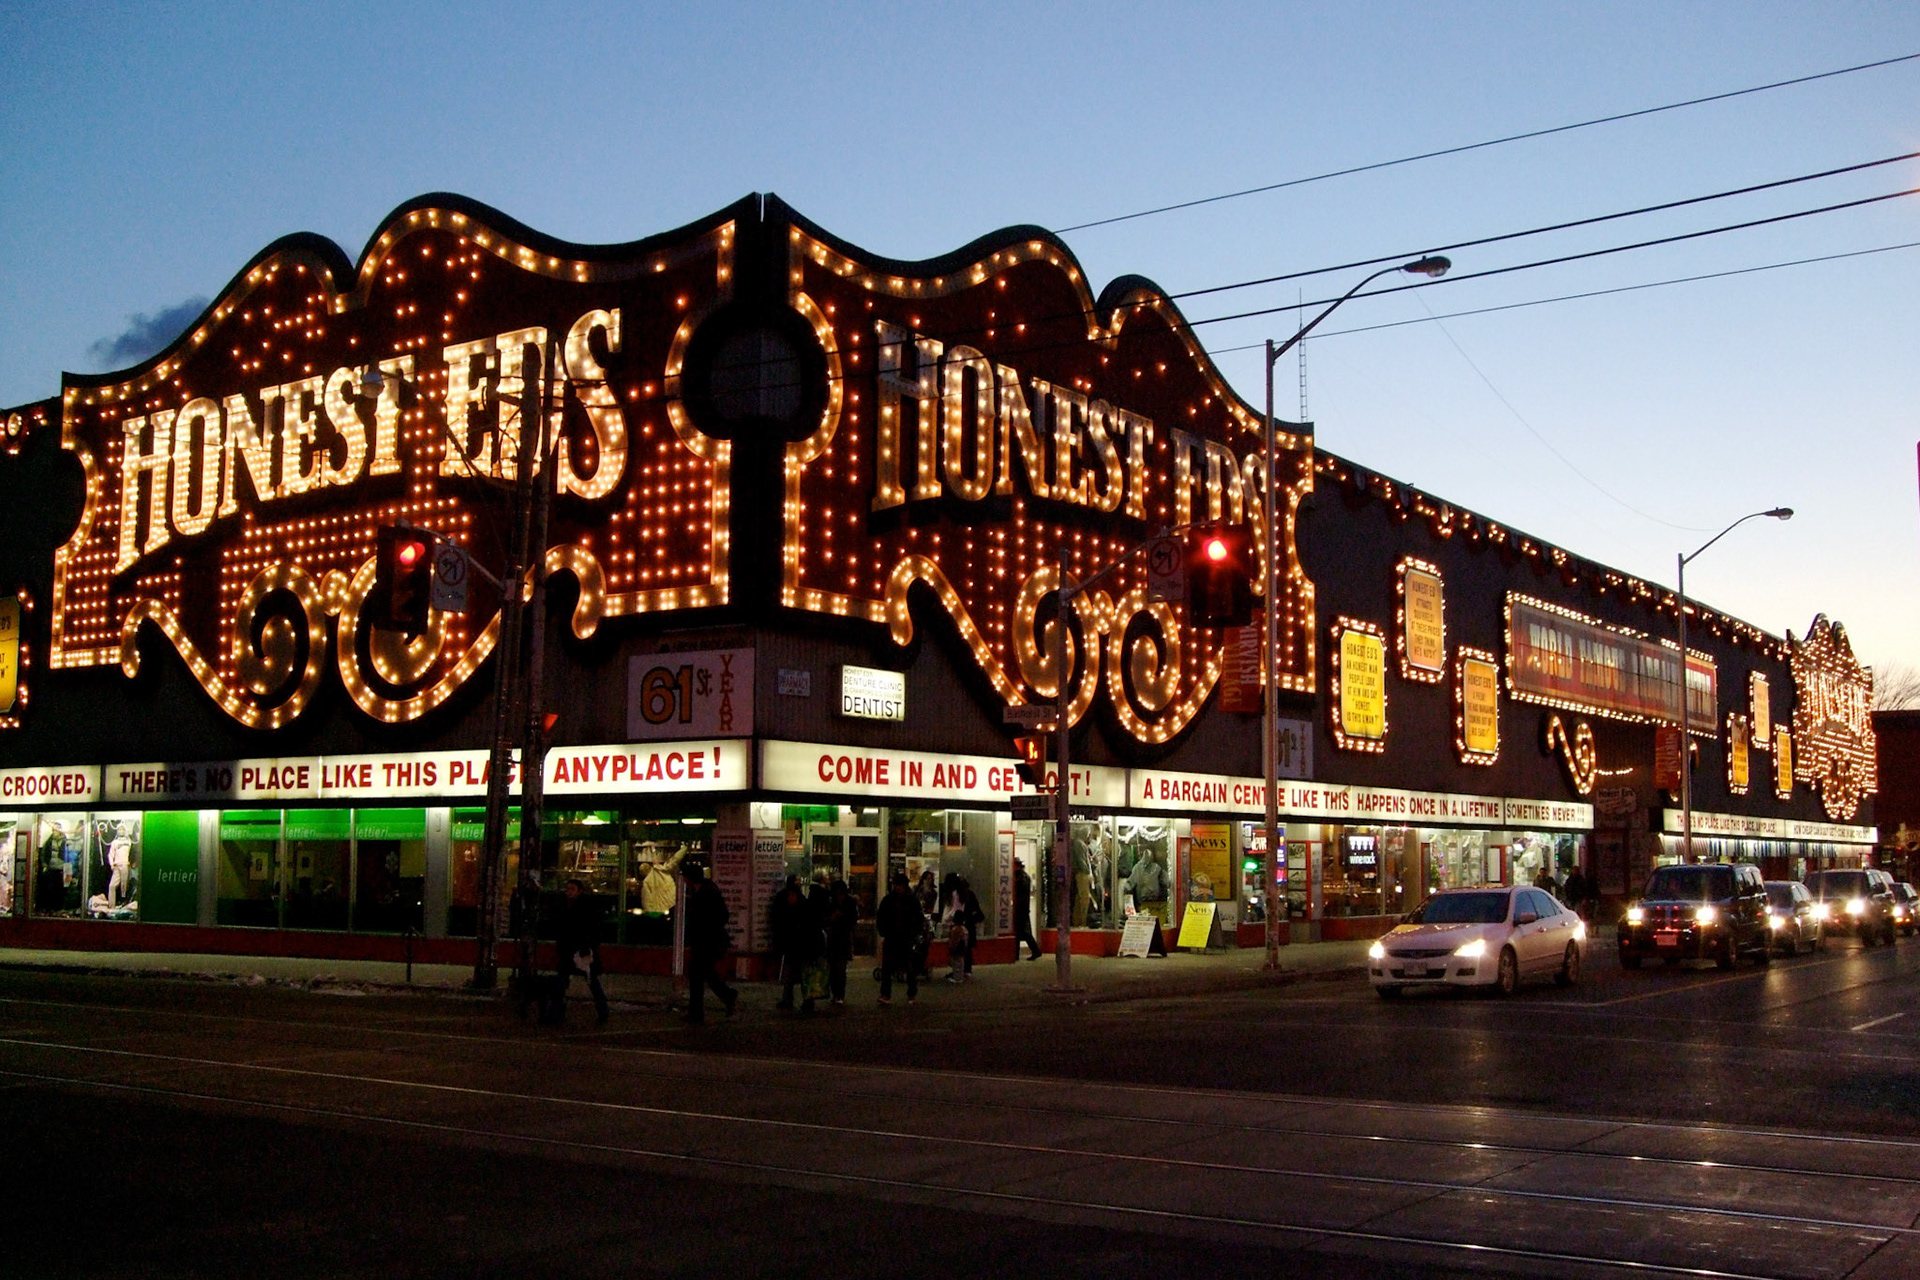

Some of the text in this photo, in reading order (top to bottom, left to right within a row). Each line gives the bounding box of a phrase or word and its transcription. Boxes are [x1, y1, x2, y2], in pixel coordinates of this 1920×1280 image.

[871, 319, 1153, 520] HONEST
[115, 354, 415, 575] HONEST
[1346, 643, 1378, 660] HONEST ED'S
[844, 668, 862, 676] HONEST
[1353, 661, 1367, 672] HONEST
[1369, 664, 1378, 674] MAN
[844, 676, 902, 691] DENTURE CLINIC
[1349, 673, 1375, 686] PEOPLE LOOK
[641, 654, 734, 731] 61 St. YEAR
[844, 695, 902, 719] DENTIST
[1352, 712, 1361, 723] THIS
[119, 767, 197, 794] THERE'S
[206, 768, 232, 792] NO
[242, 765, 309, 791] PLACE
[322, 763, 372, 789] LIKE
[383, 761, 437, 787] THIS
[818, 754, 889, 786] COME
[900, 760, 923, 788] IN
[932, 763, 978, 790] AND
[2, 773, 92, 797] CROOKED.
[1143, 777, 1499, 818] A BARGAIN CENTE LIKE THIS HAPPENS ONCE IN A LIFETIME
[1506, 803, 1549, 821] SOMETIMES
[1552, 806, 1576, 822] NEVER
[1705, 817, 1719, 830] PLACE
[1731, 819, 1740, 831] THIS
[717, 840, 748, 852] lettieri
[755, 840, 784, 852] lettieri
[1190, 837, 1227, 849] News
[158, 868, 198, 883] lettieri
[1000, 843, 1009, 930] ENTRANCE
[1188, 904, 1212, 915] News
